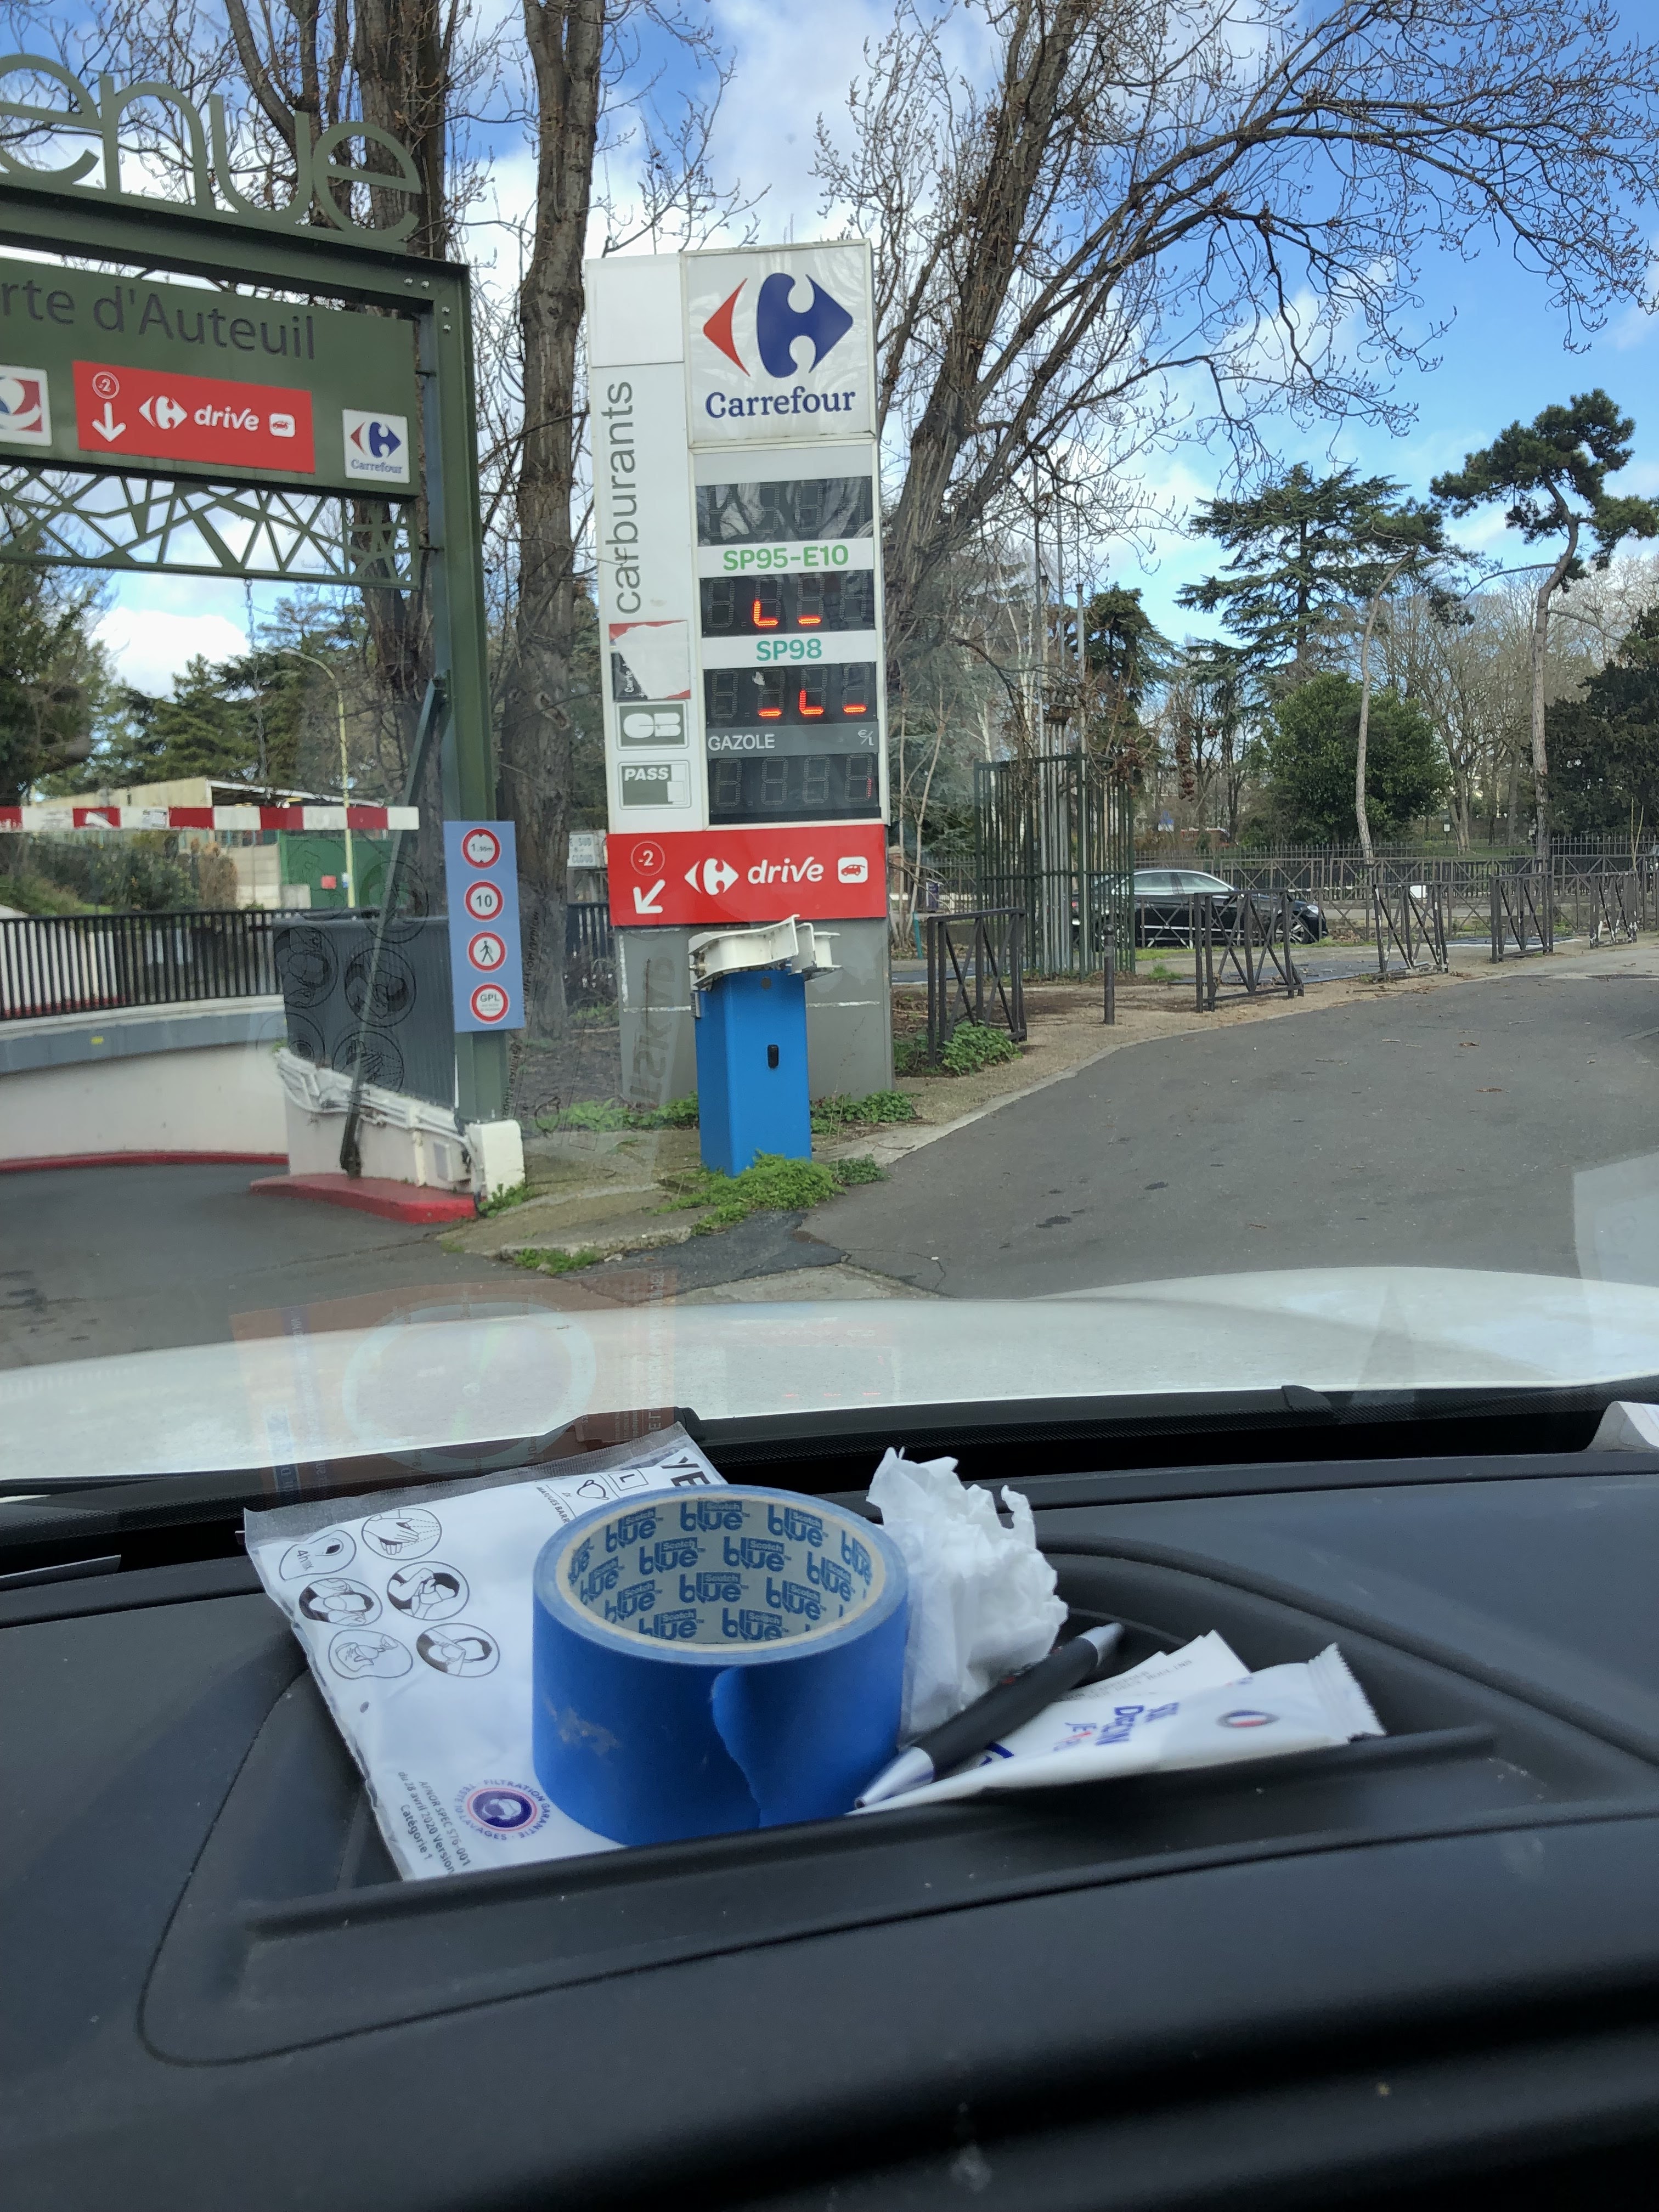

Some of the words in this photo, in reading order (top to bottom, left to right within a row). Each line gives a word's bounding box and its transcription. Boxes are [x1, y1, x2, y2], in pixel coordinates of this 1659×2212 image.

[93, 286, 315, 360] d'Auteuil
[194, 404, 259, 431] drive
[705, 386, 855, 419] Carrefour
[351, 459, 402, 474] Carrefour
[601, 381, 641, 613] carburants
[723, 545, 848, 571] SP95-E10
[756, 639, 822, 661] SP98
[708, 733, 775, 751] GAZOLE
[624, 768, 669, 781] PASS
[638, 850, 653, 866] -2
[748, 856, 823, 884] drive
[476, 895, 493, 907] 10
[480, 994, 500, 1002] GPL
[619, 1474, 635, 1483] L
[680, 1500, 743, 1531] blue
[768, 1504, 823, 1548] blue
[606, 1517, 657, 1553] blue
[749, 1541, 782, 1553] Scotch
[639, 1542, 698, 1576] blue
[723, 1536, 785, 1572] blue
[679, 1572, 741, 1603] blue
[705, 1575, 739, 1583] Scotch
[806, 1550, 851, 1602] blue
[766, 1577, 821, 1621] blue
[722, 1607, 782, 1640] blue
[748, 1613, 780, 1624] Scotch
[398, 1772, 408, 1781] du
[404, 1782, 416, 1791] 28
[410, 1793, 428, 1811] avril
[421, 1812, 438, 1835] 2020
[419, 1781, 441, 1807] AFNOR
[435, 1807, 453, 1827] SPEC
[484, 1779, 545, 1802] FILTRATION
[518, 1803, 550, 1838] GARANTIE
[400, 1804, 427, 1853] Catégorie
[459, 1815, 507, 1840] LAVAGES
